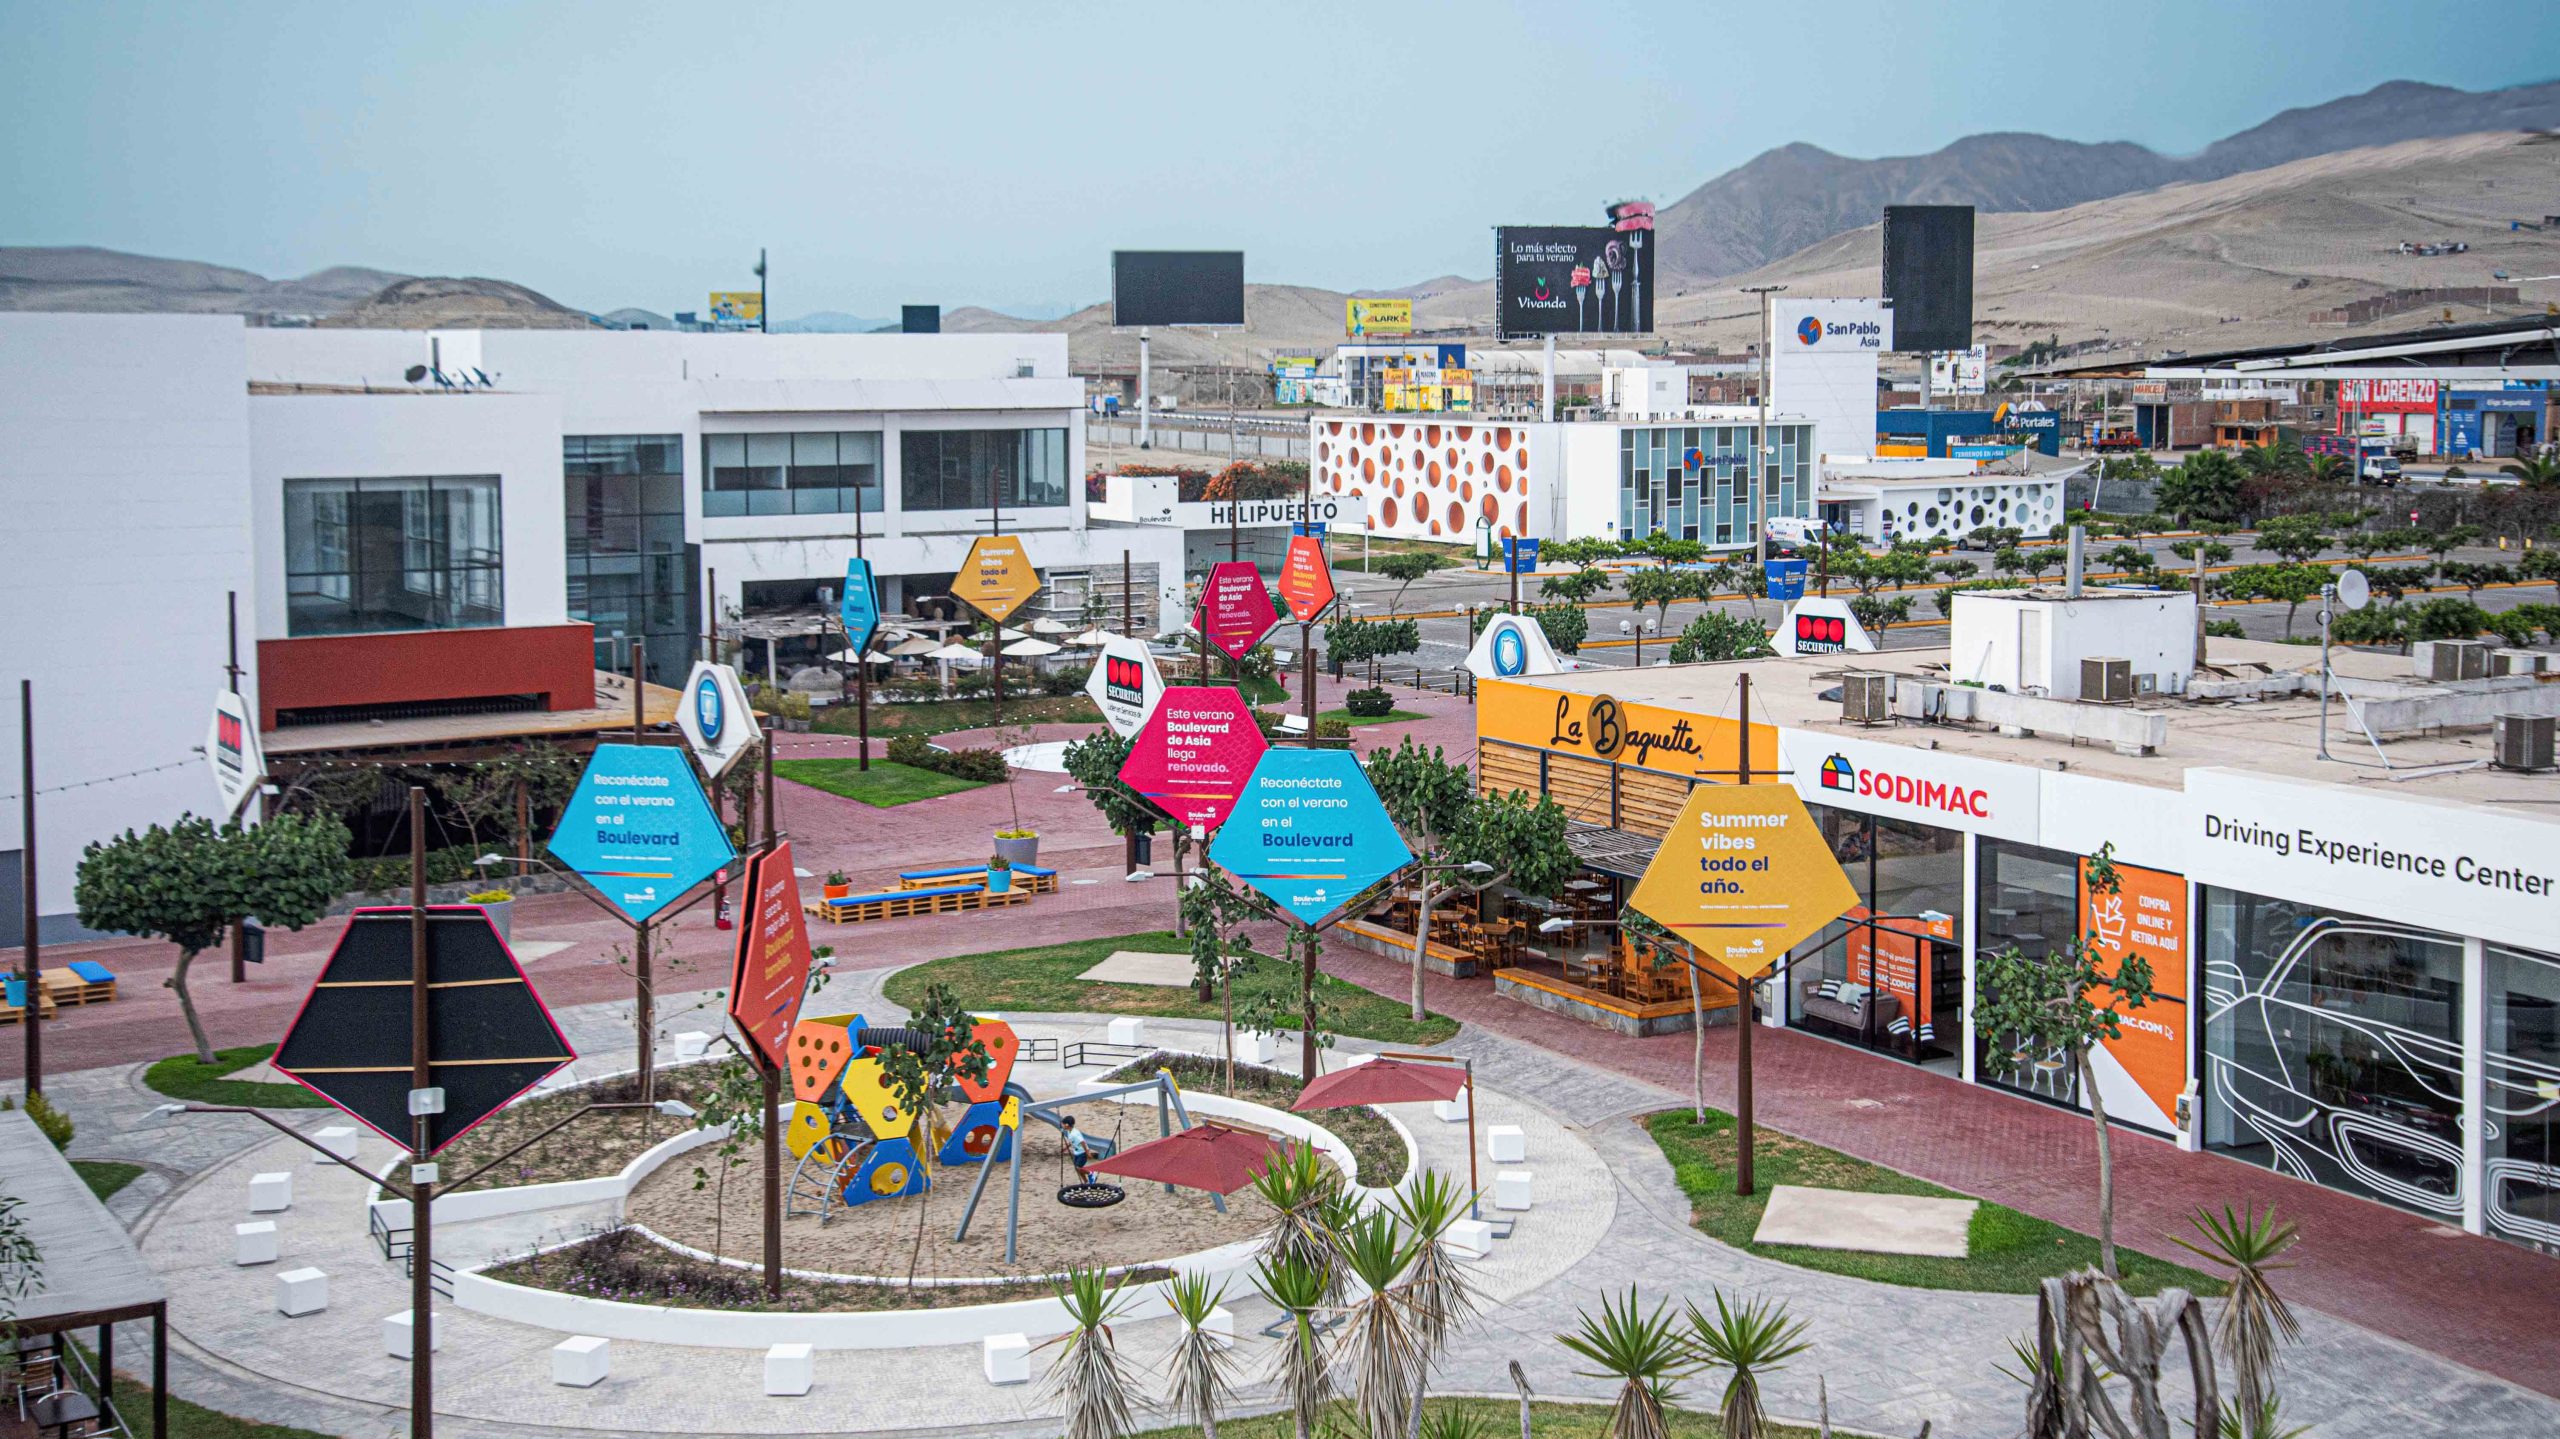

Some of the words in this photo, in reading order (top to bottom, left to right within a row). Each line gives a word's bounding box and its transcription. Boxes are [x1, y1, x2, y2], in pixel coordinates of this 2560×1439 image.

[1511, 242, 1523, 254] Lo
[1525, 242, 1543, 253] más
[1545, 242, 1577, 254] selecto
[1516, 254, 1534, 264] para
[1536, 254, 1545, 262] tu
[1546, 254, 1574, 263] verano
[1517, 296, 1567, 309] Vivanda
[1826, 321, 1847, 335] San
[1849, 321, 1881, 335] Pablo
[1860, 335, 1880, 348] Asia
[2343, 378, 2370, 402] SAN
[2373, 378, 2436, 404] LORENZO
[2020, 416, 2055, 428] Portales
[1139, 515, 1172, 523] Boulevard
[1210, 503, 1338, 524] HELIPUERTO
[980, 548, 1016, 556] Summer
[980, 559, 1003, 567] vibes
[980, 568, 1000, 576] todo
[1001, 567, 1008, 575] el
[1218, 584, 1251, 593] Boulevard
[1228, 593, 1243, 601] Asia
[1218, 603, 1235, 612] llega
[1798, 640, 1843, 654] SECURITAS
[1108, 685, 1142, 704] SECURITAS
[1166, 708, 1191, 719] Este
[1192, 710, 1235, 720] verano
[1166, 721, 1230, 734] Boulevard
[1550, 694, 1584, 746] La
[1592, 699, 1702, 766] Baguette
[1167, 734, 1183, 746] de
[1184, 735, 1212, 747] Asia
[1167, 748, 1197, 762] llega
[1167, 762, 1230, 773] renovado.
[593, 773, 670, 787] Reconéctate
[1260, 776, 1342, 789] Reconéctate
[1858, 768, 1988, 818] SODIMAC
[594, 796, 618, 806] con
[619, 794, 631, 806] el
[632, 796, 676, 807] verano
[1260, 798, 1286, 808] con
[1288, 796, 1300, 808] el
[1302, 798, 1349, 809] verano
[595, 815, 611, 825] en
[612, 813, 625, 825] el
[1261, 818, 1278, 828] en
[1280, 816, 1293, 828] el
[1700, 811, 1789, 828] Summer
[596, 830, 680, 846] Boulevard
[1262, 833, 1354, 848] Boulevard
[1700, 833, 1756, 850] vibes
[2204, 813, 2290, 857] Driving
[2297, 828, 2447, 879] Experience
[2455, 856, 2555, 897] Center
[1700, 855, 1747, 872] todo
[1751, 855, 1769, 872] el
[1700, 878, 1745, 894] año.
[1292, 895, 1327, 903] Boulevard
[2138, 894, 2172, 913] COMPRA
[2136, 911, 2166, 931] ONLINE
[2166, 918, 2174, 932] Y
[765, 926, 795, 960] Boulevard
[2130, 928, 2159, 948] RETIRA
[2159, 935, 2179, 952] AQUÍ
[1725, 945, 1764, 954] Boulevard
